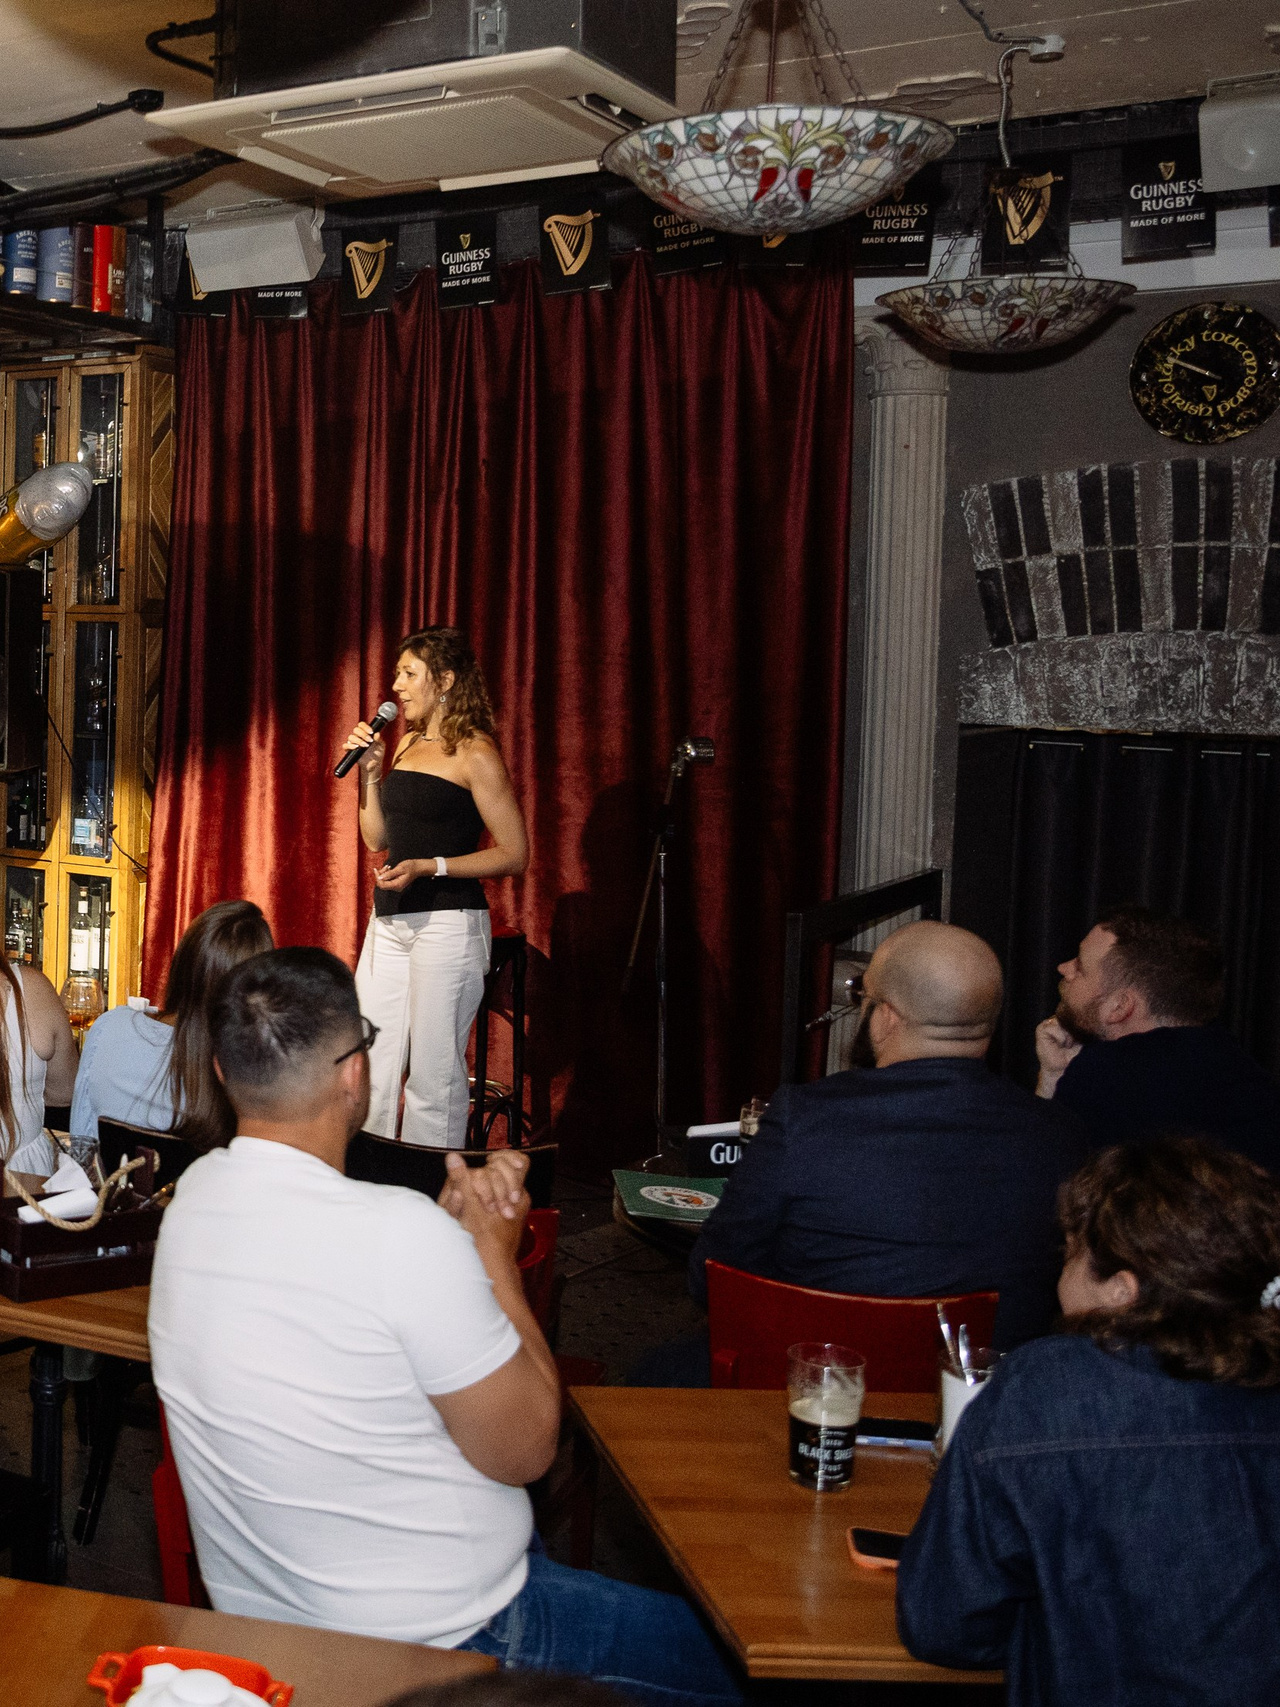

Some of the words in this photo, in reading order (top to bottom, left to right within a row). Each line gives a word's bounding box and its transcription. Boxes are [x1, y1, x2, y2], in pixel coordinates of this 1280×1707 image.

[1129, 178, 1203, 200] GUINNESS
[865, 203, 929, 218] GUINNESS
[1141, 194, 1194, 212] RUGBY
[873, 217, 918, 230] RUGBY
[1130, 218, 1158, 228] MADE
[1160, 216, 1175, 225] OF
[1176, 212, 1206, 223] MORE
[656, 243, 678, 253] MADE
[692, 236, 716, 246] MORE
[900, 234, 925, 243] MORE
[441, 247, 491, 265] GUINNESS
[449, 260, 484, 275] RUGBY
[441, 280, 460, 288] MADE
[472, 275, 491, 284] MORE
[798, 1442, 832, 1461] BLACK
